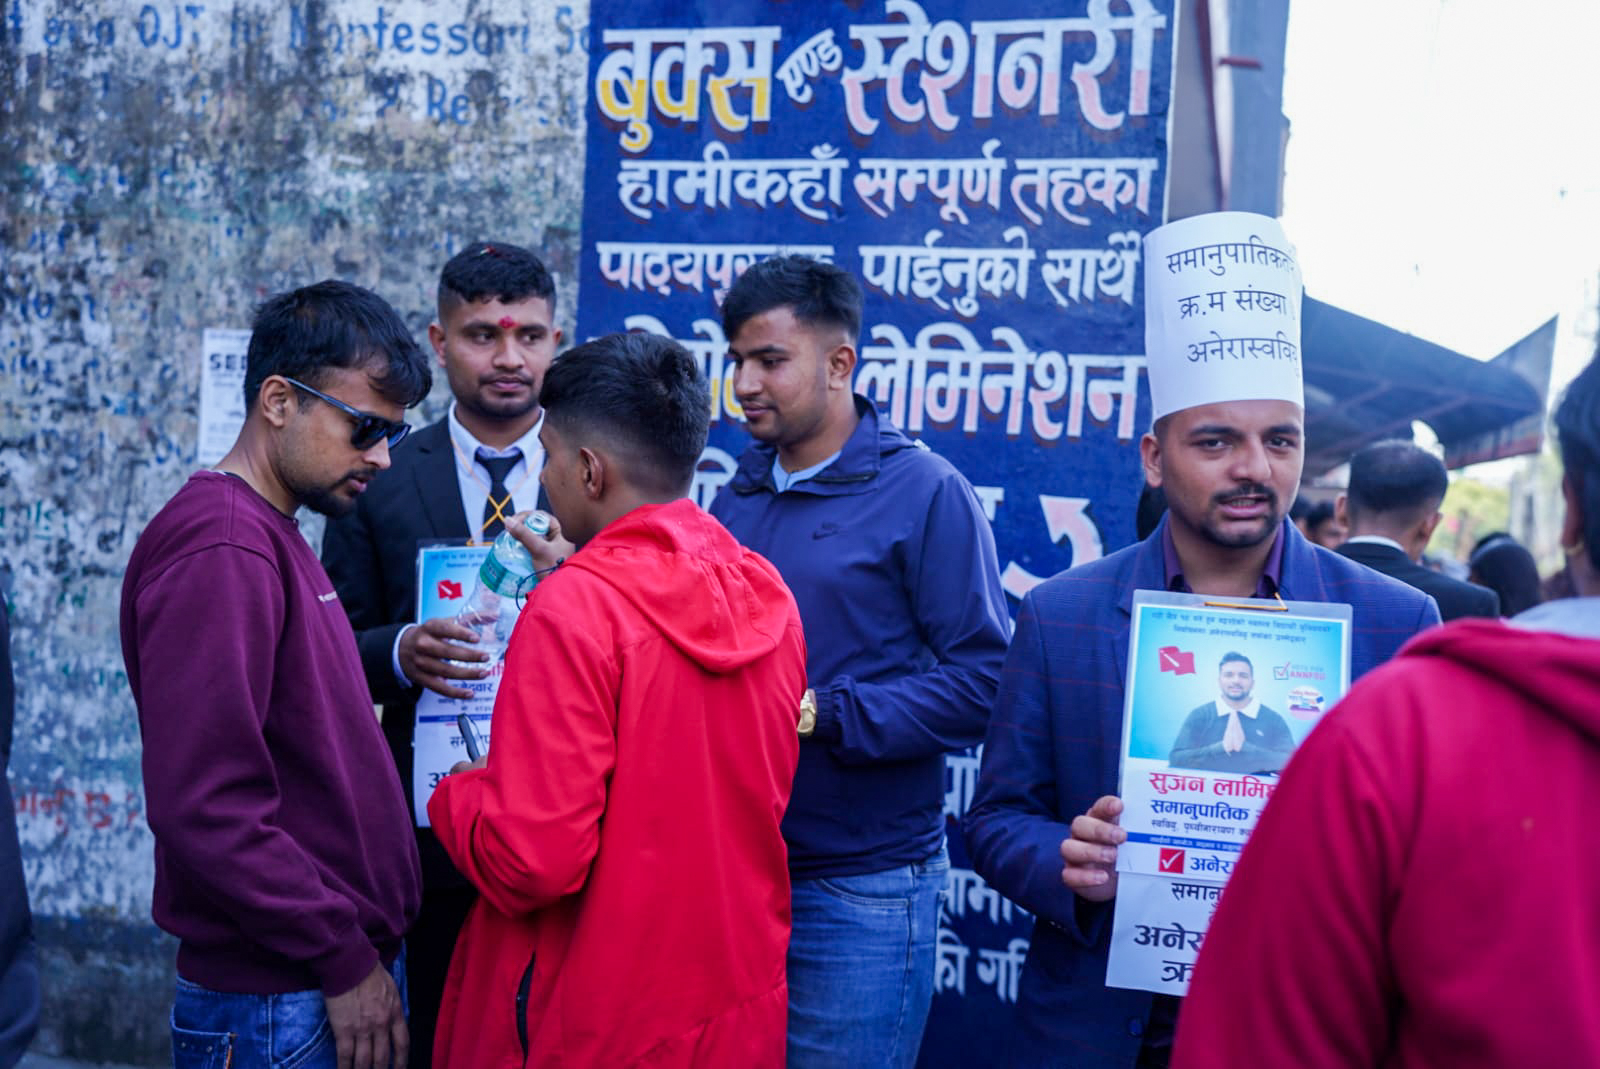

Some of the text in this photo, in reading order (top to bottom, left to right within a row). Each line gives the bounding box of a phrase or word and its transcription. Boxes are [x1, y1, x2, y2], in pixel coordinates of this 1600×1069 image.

[599, 27, 781, 152] बुक्स
[776, 28, 844, 104] एण्ड
[841, 0, 1167, 135] स्टेशनरी
[617, 139, 1159, 226] हामीकहाँ सम्पूर्ण तहका
[1041, 230, 1142, 308] साथै
[1233, 284, 1287, 316] संख्या
[856, 321, 1148, 440] लेमिनेशन
[1149, 772, 1206, 794] सुजन
[1150, 799, 1250, 820] समानुपातिक
